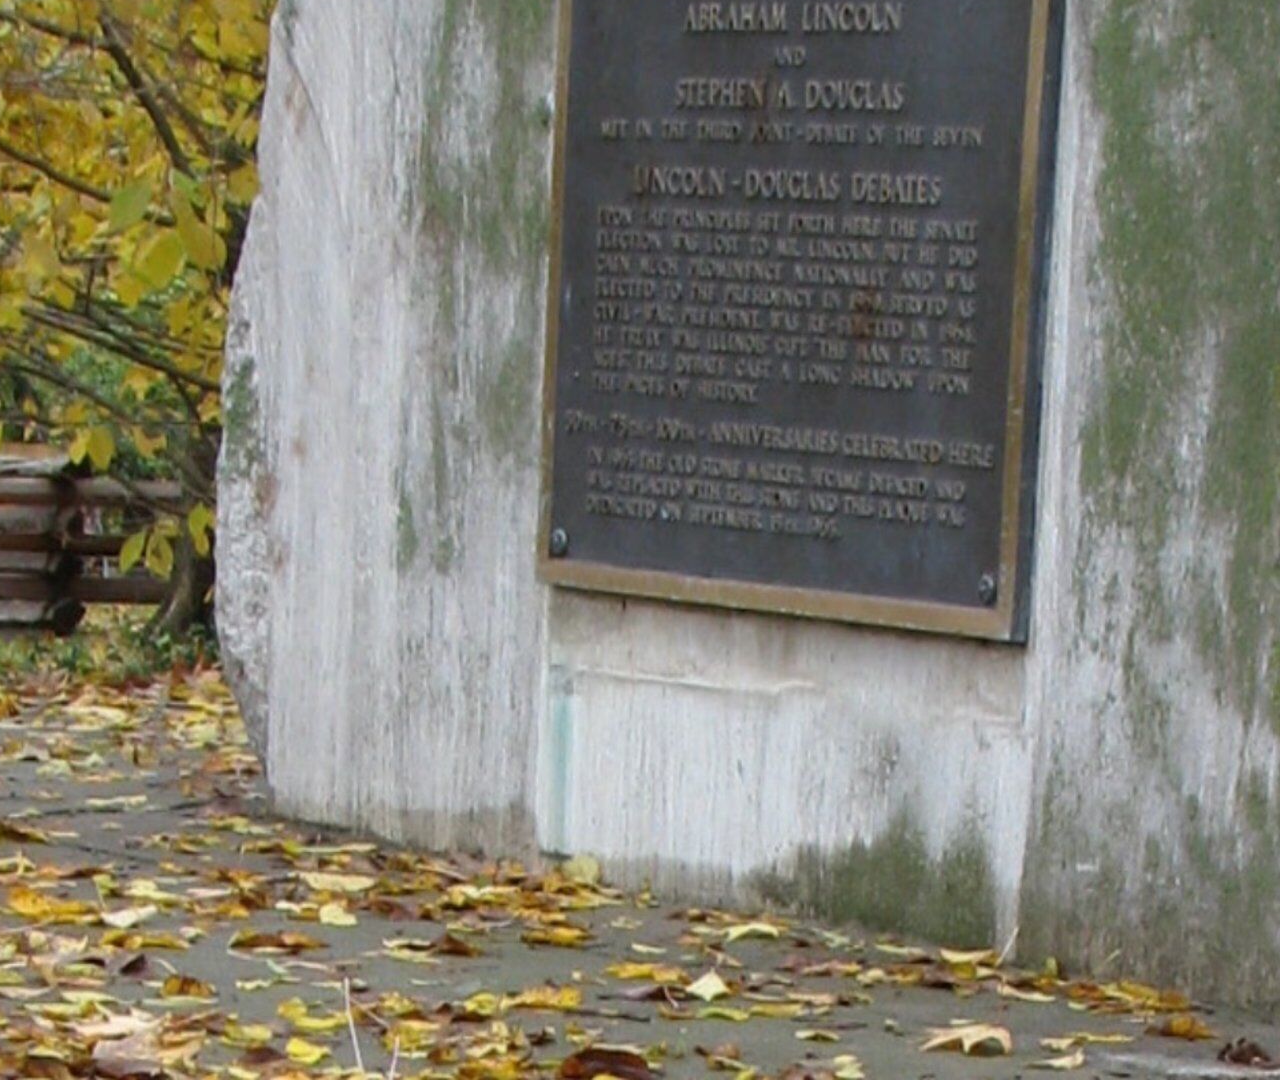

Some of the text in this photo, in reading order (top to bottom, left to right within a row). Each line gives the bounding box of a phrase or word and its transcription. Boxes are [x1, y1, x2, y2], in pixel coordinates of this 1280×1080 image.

[681, 0, 903, 32] ABRAHAM LINCOLN
[773, 44, 807, 65] AND
[673, 76, 764, 106] STEPHEN
[804, 79, 905, 110] DOUGLAS
[635, 117, 652, 136] IN
[660, 116, 687, 136] THE
[866, 123, 885, 144] OF
[894, 123, 924, 145] THE
[932, 124, 982, 146] SEVEN
[850, 171, 943, 204] DEBATES
[841, 214, 882, 236] HERE
[888, 216, 918, 238] THE
[918, 244, 938, 264] HE
[948, 245, 978, 266] DID
[793, 263, 887, 286] NATIONALLY
[900, 268, 935, 289] AND
[944, 271, 976, 292] WAS
[821, 289, 841, 309] IN
[957, 297, 976, 318] AS
[911, 319, 928, 339] IN
[899, 344, 932, 365] FOR
[940, 347, 970, 369] THE
[799, 362, 841, 384] LONG
[669, 377, 690, 398] OF
[840, 430, 945, 463] CELEBRATED
[947, 439, 994, 468] HERE
[934, 477, 966, 501] AND
[807, 491, 838, 513] AND
